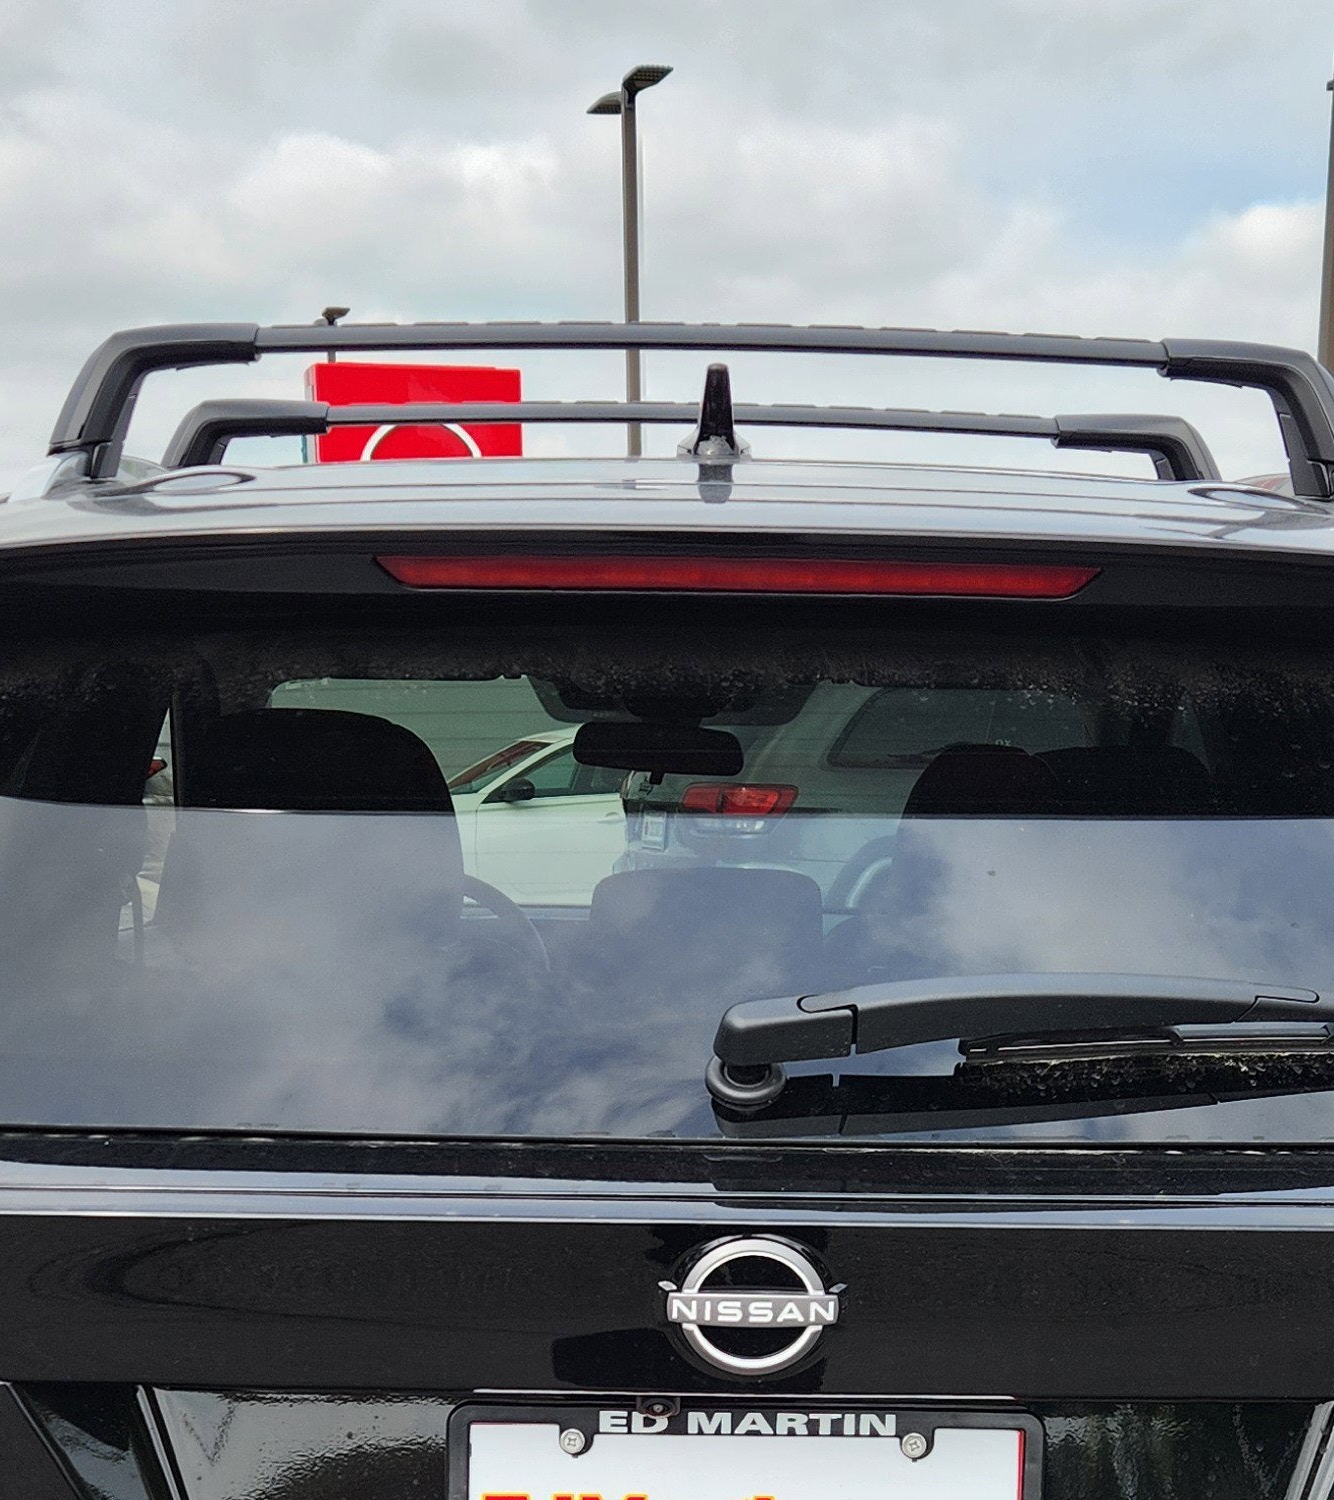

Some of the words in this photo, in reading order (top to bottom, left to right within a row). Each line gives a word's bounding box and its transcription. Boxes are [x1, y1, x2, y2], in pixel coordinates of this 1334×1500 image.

[670, 1295, 838, 1324] NISSAN
[598, 1410, 669, 1436] ED
[687, 1411, 898, 1438] MARTIN
